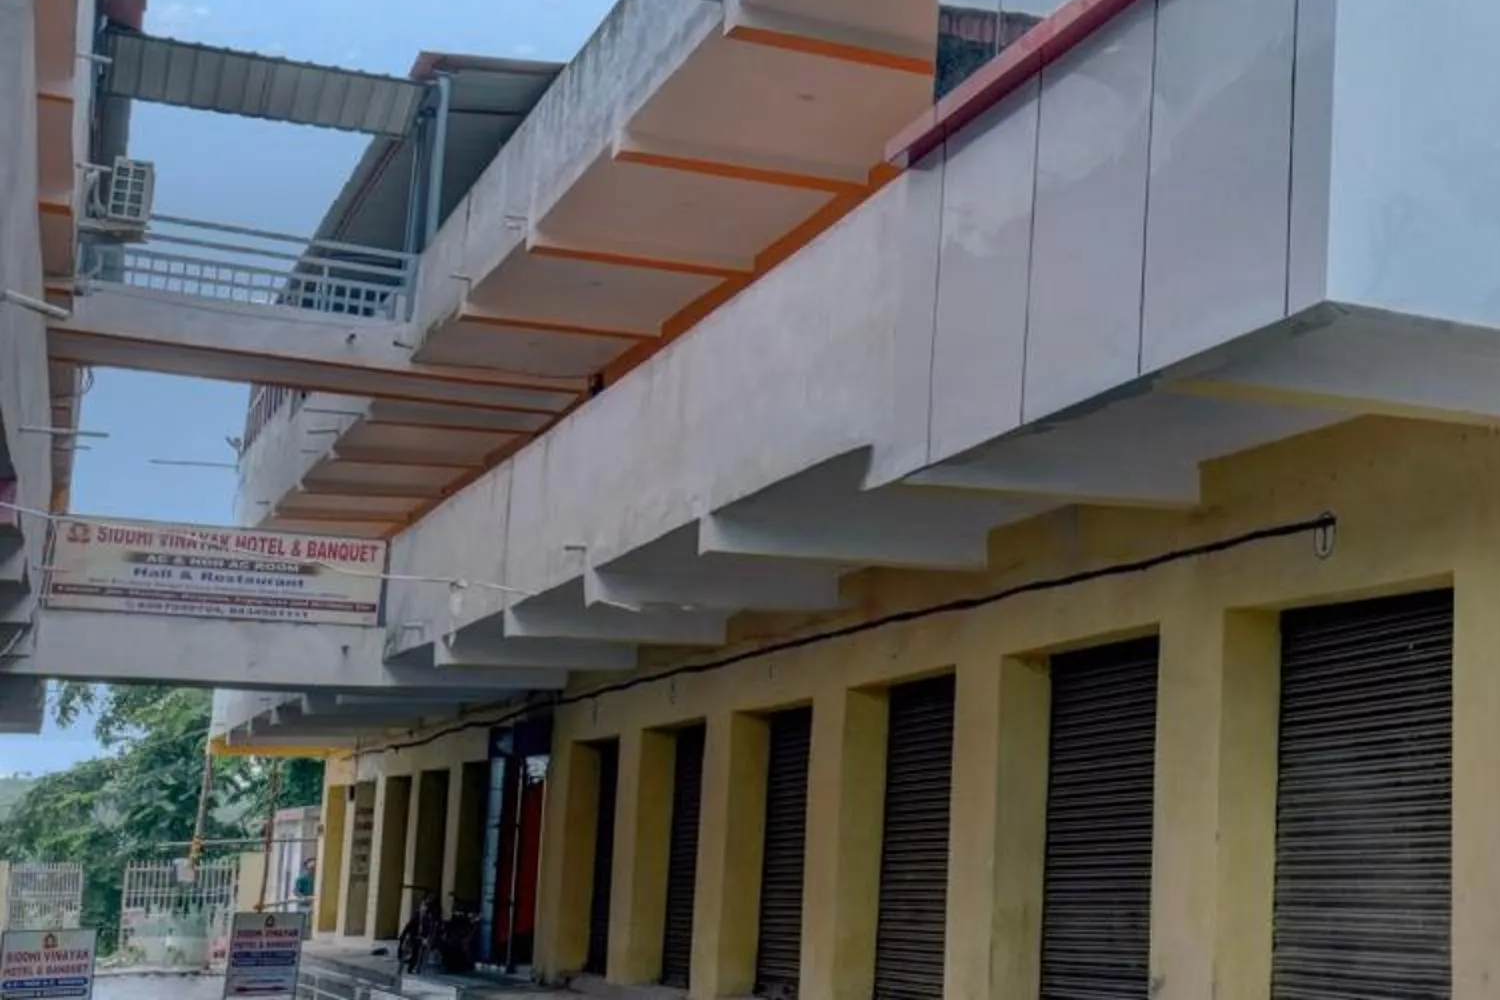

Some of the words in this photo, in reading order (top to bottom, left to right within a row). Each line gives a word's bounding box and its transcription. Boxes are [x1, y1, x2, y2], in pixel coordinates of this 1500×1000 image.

[235, 535, 285, 556] HOTEL
[291, 540, 302, 557] &
[306, 540, 379, 562] BANQUET
